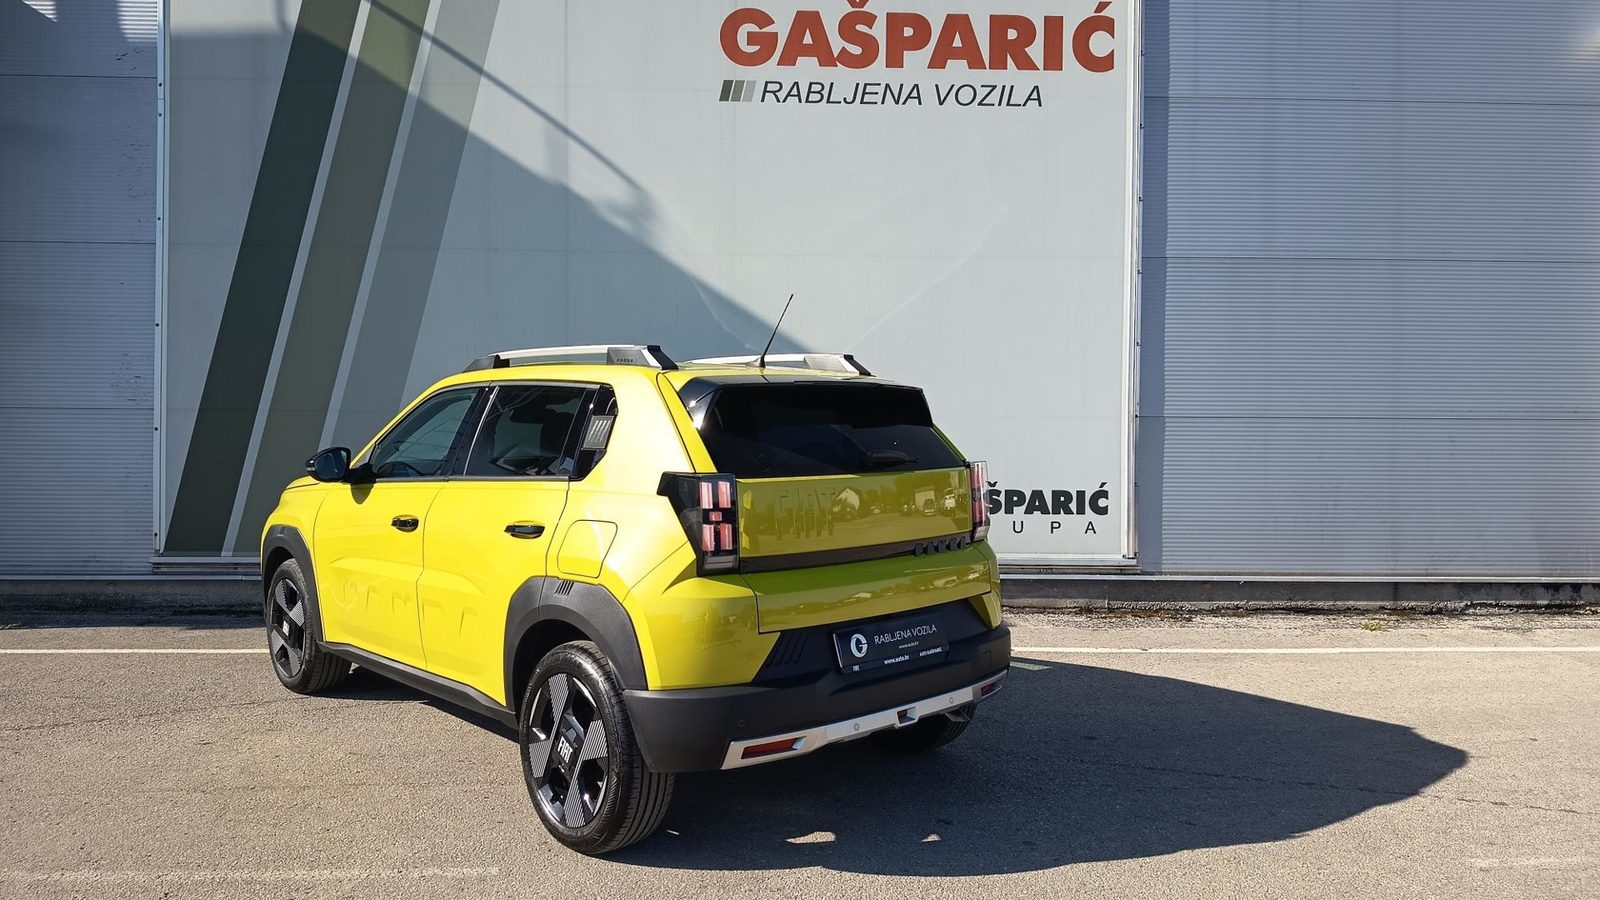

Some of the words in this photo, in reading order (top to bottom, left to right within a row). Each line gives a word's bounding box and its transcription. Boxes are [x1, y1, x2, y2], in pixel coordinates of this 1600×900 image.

[719, 0, 1116, 73] GAŠPARIĆ
[760, 80, 922, 106] RABLJENA
[934, 83, 1043, 107] VOZILA
[984, 481, 1109, 516] ŠPARIĆ
[1012, 520, 1097, 534] UPA
[874, 629, 912, 644] RABLJENA
[912, 624, 937, 636] VOZILA
[557, 735, 574, 764] FIAT
